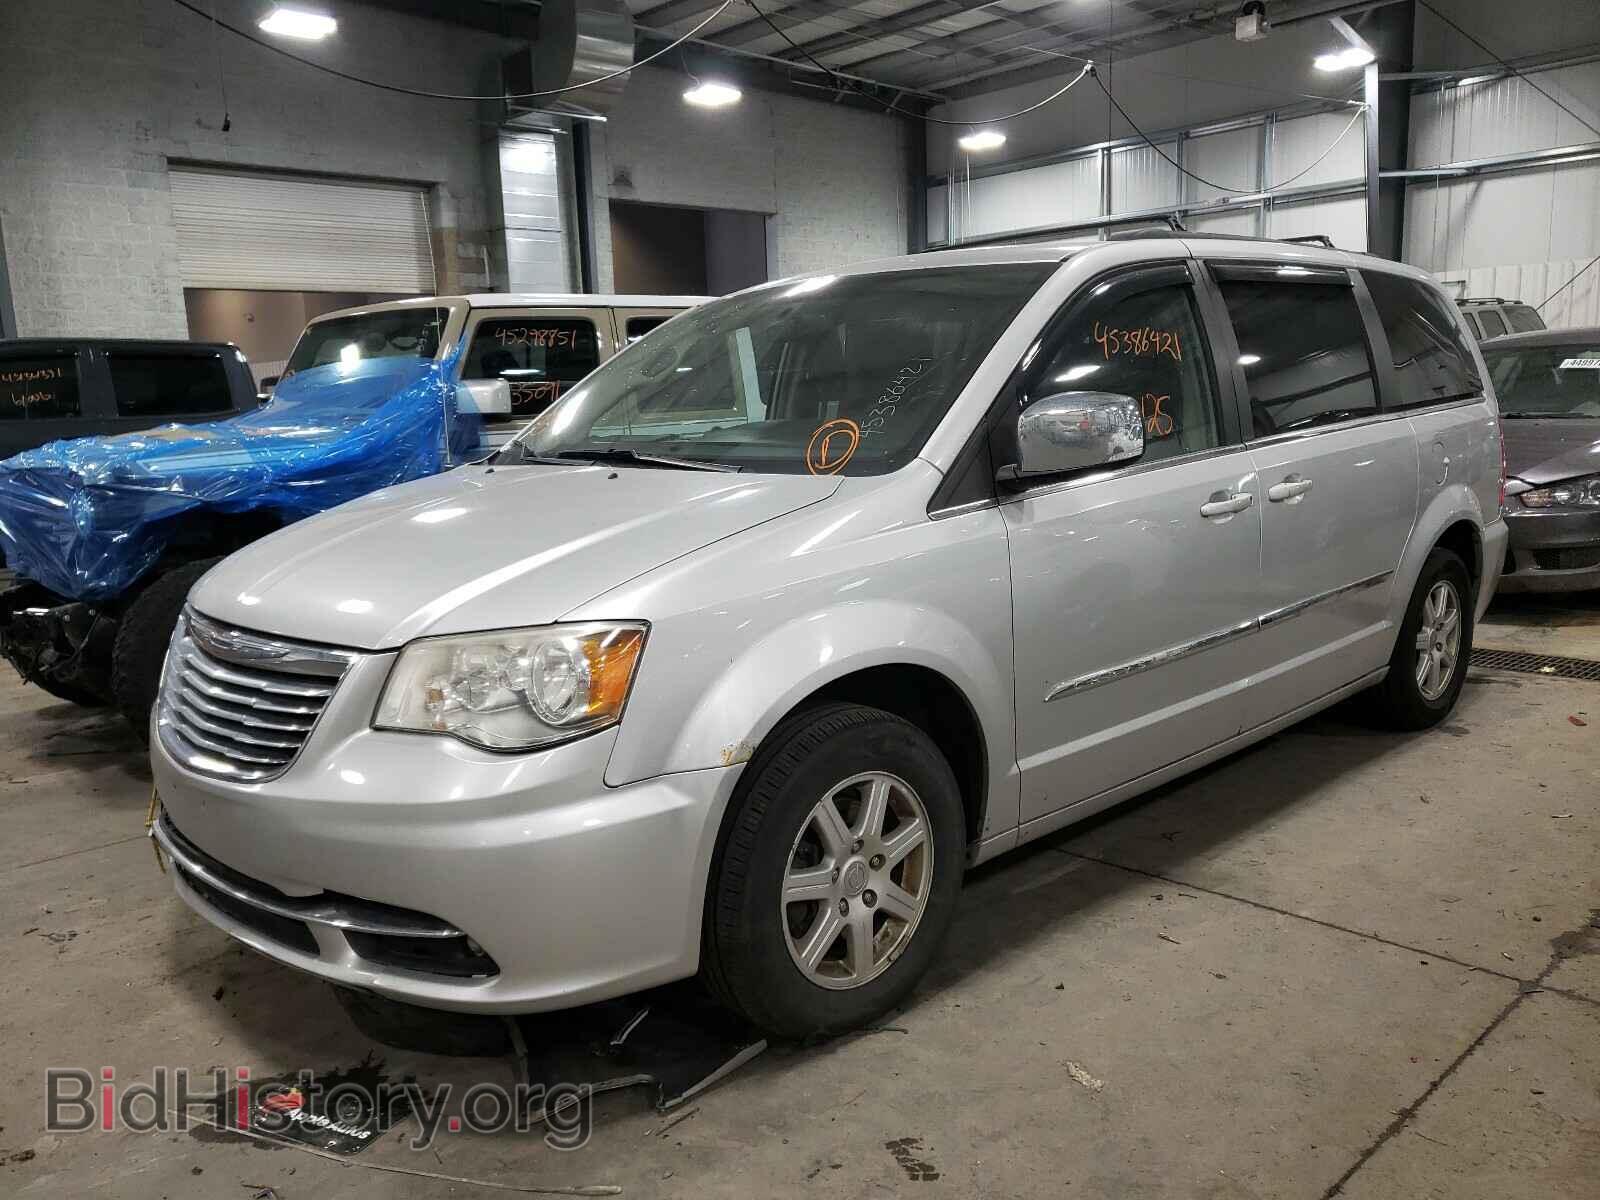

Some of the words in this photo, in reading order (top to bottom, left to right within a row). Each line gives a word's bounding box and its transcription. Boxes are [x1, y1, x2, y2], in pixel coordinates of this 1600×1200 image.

[495, 327, 577, 351] 45298851
[1094, 322, 1182, 361] 45386421
[286, 1108, 330, 1126] Apple
